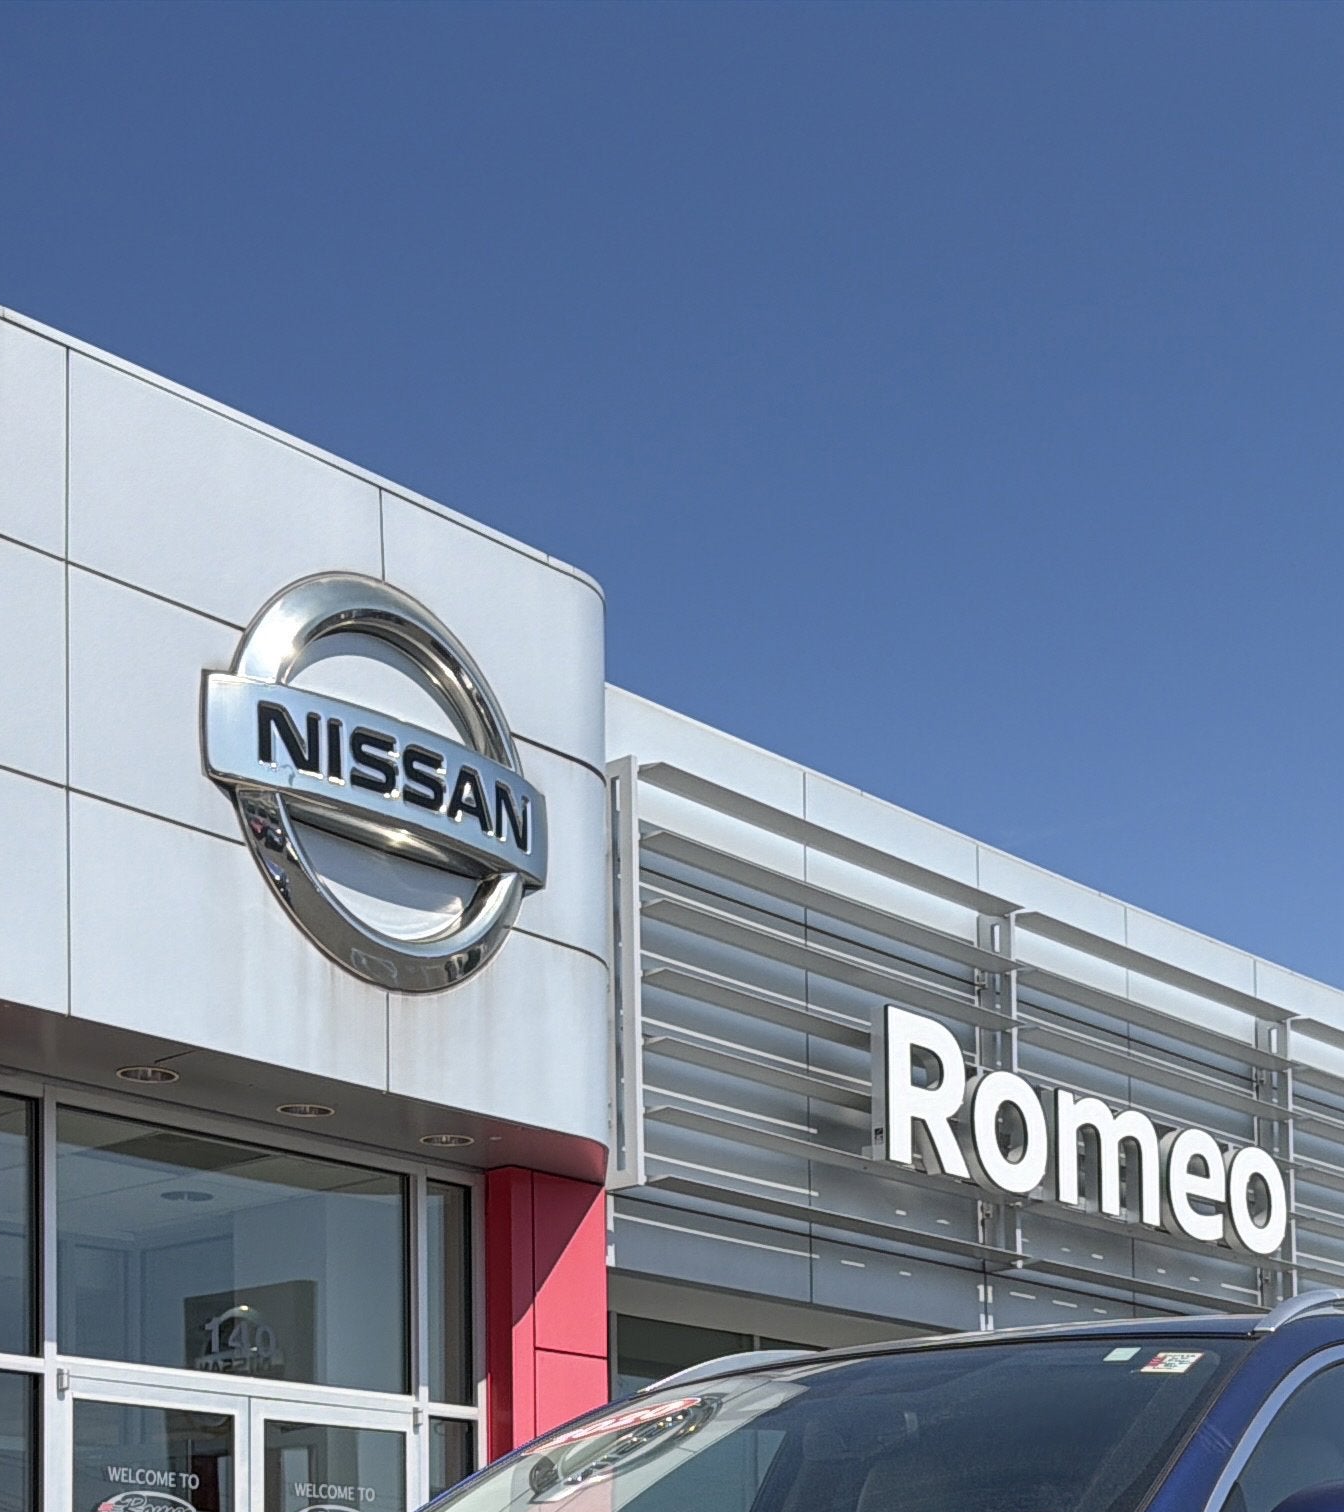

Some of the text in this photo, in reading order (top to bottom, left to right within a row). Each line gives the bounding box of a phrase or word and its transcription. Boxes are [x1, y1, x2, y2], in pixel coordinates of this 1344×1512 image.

[256, 700, 533, 855] NISSAN
[884, 1003, 1288, 1256] Romeo
[204, 1316, 276, 1358] 140
[108, 1466, 200, 1490] WELCOME TO
[294, 1483, 375, 1502] WELCOME TO
